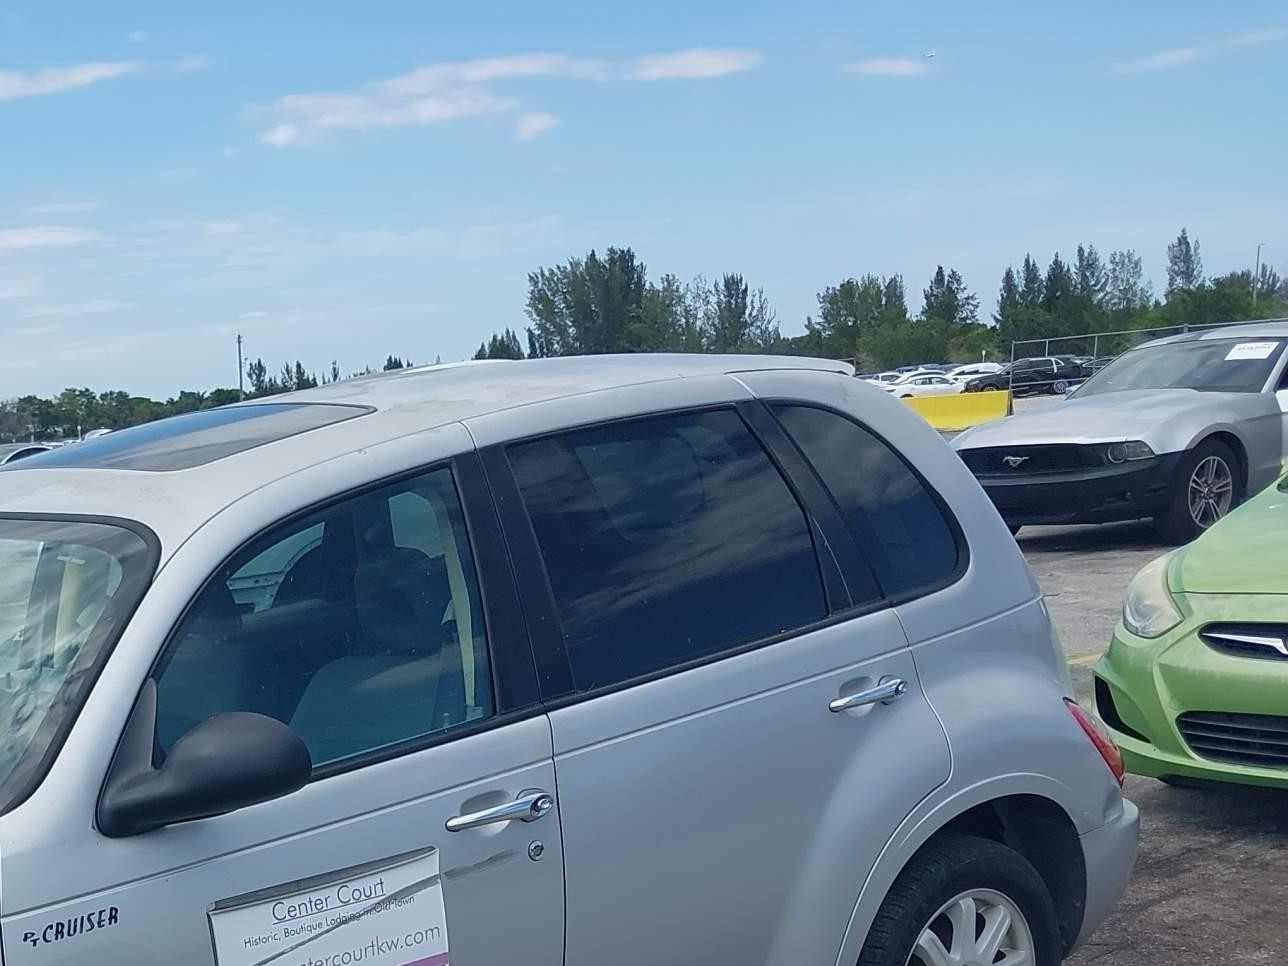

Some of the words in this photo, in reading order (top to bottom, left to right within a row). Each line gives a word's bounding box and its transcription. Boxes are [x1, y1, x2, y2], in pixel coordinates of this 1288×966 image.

[272, 896, 330, 922] Center
[336, 877, 385, 904] Court
[42, 906, 119, 943] CRUISER
[243, 932, 282, 949] Historic,
[284, 920, 323, 939] Boutique
